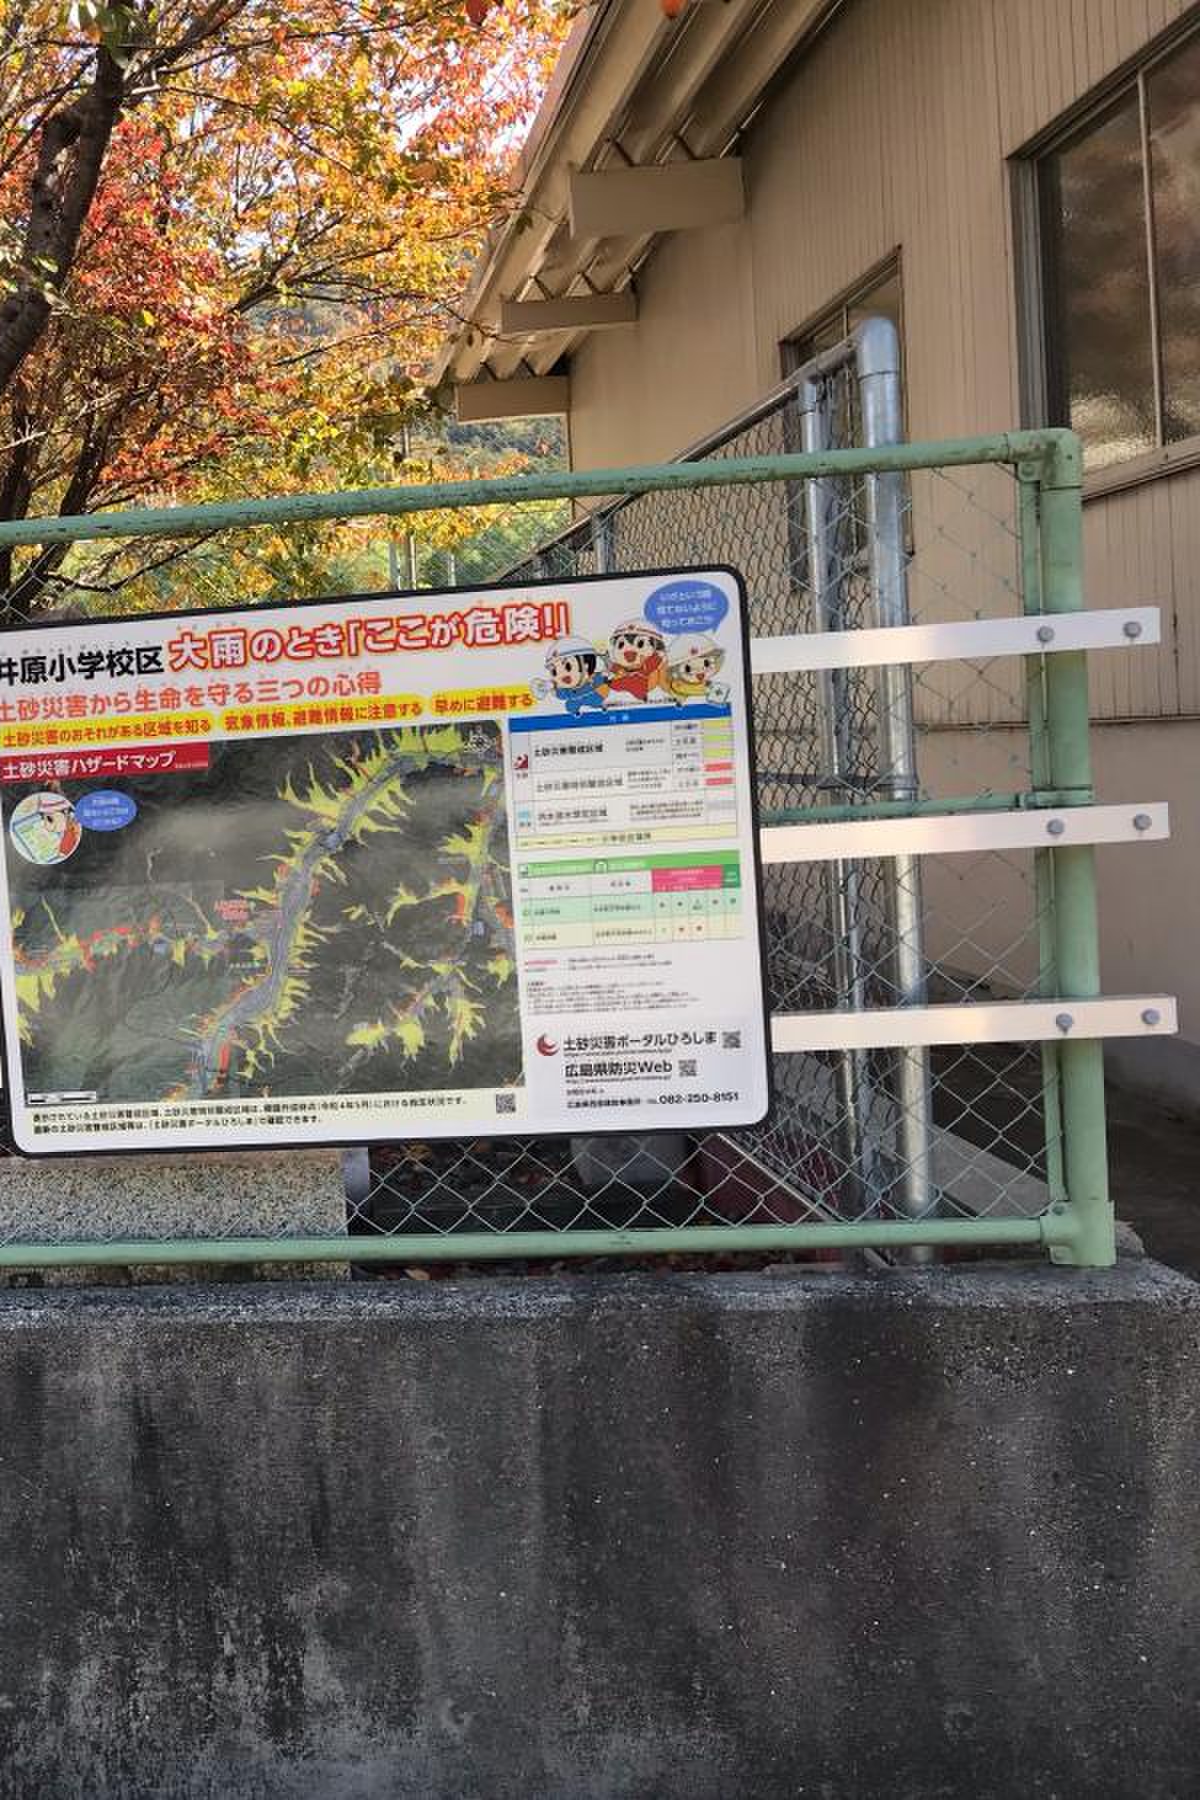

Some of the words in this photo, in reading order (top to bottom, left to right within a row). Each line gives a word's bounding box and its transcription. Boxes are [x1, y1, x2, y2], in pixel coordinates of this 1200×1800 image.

[3, 750, 176, 780] 土砂災害ハザードマップ
[564, 1031, 717, 1052] 土砂災害ポータルひろしま
[565, 1060, 673, 1078] 広島県防災Web
